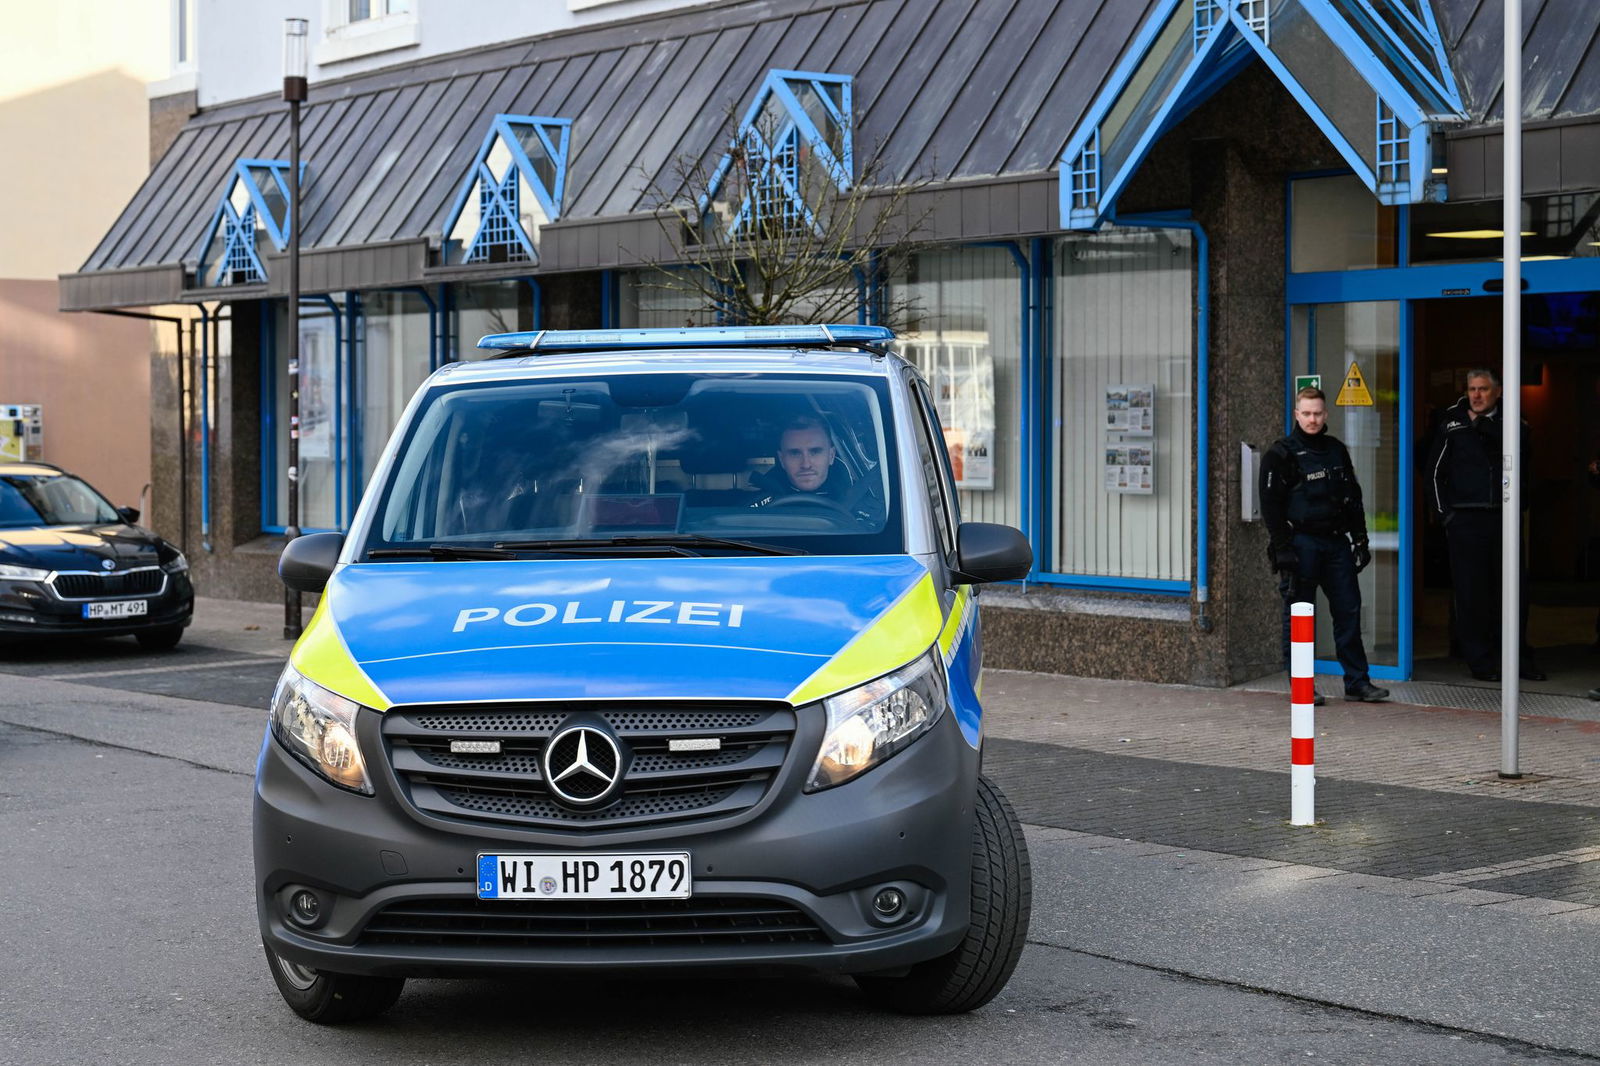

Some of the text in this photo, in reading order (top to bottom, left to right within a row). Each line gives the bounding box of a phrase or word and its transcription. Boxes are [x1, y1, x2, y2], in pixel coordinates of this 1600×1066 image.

[89, 601, 145, 616] HP MT 491
[452, 600, 744, 633] POLIZEI
[484, 881, 493, 892] D
[500, 859, 685, 893] WI HP 1879
